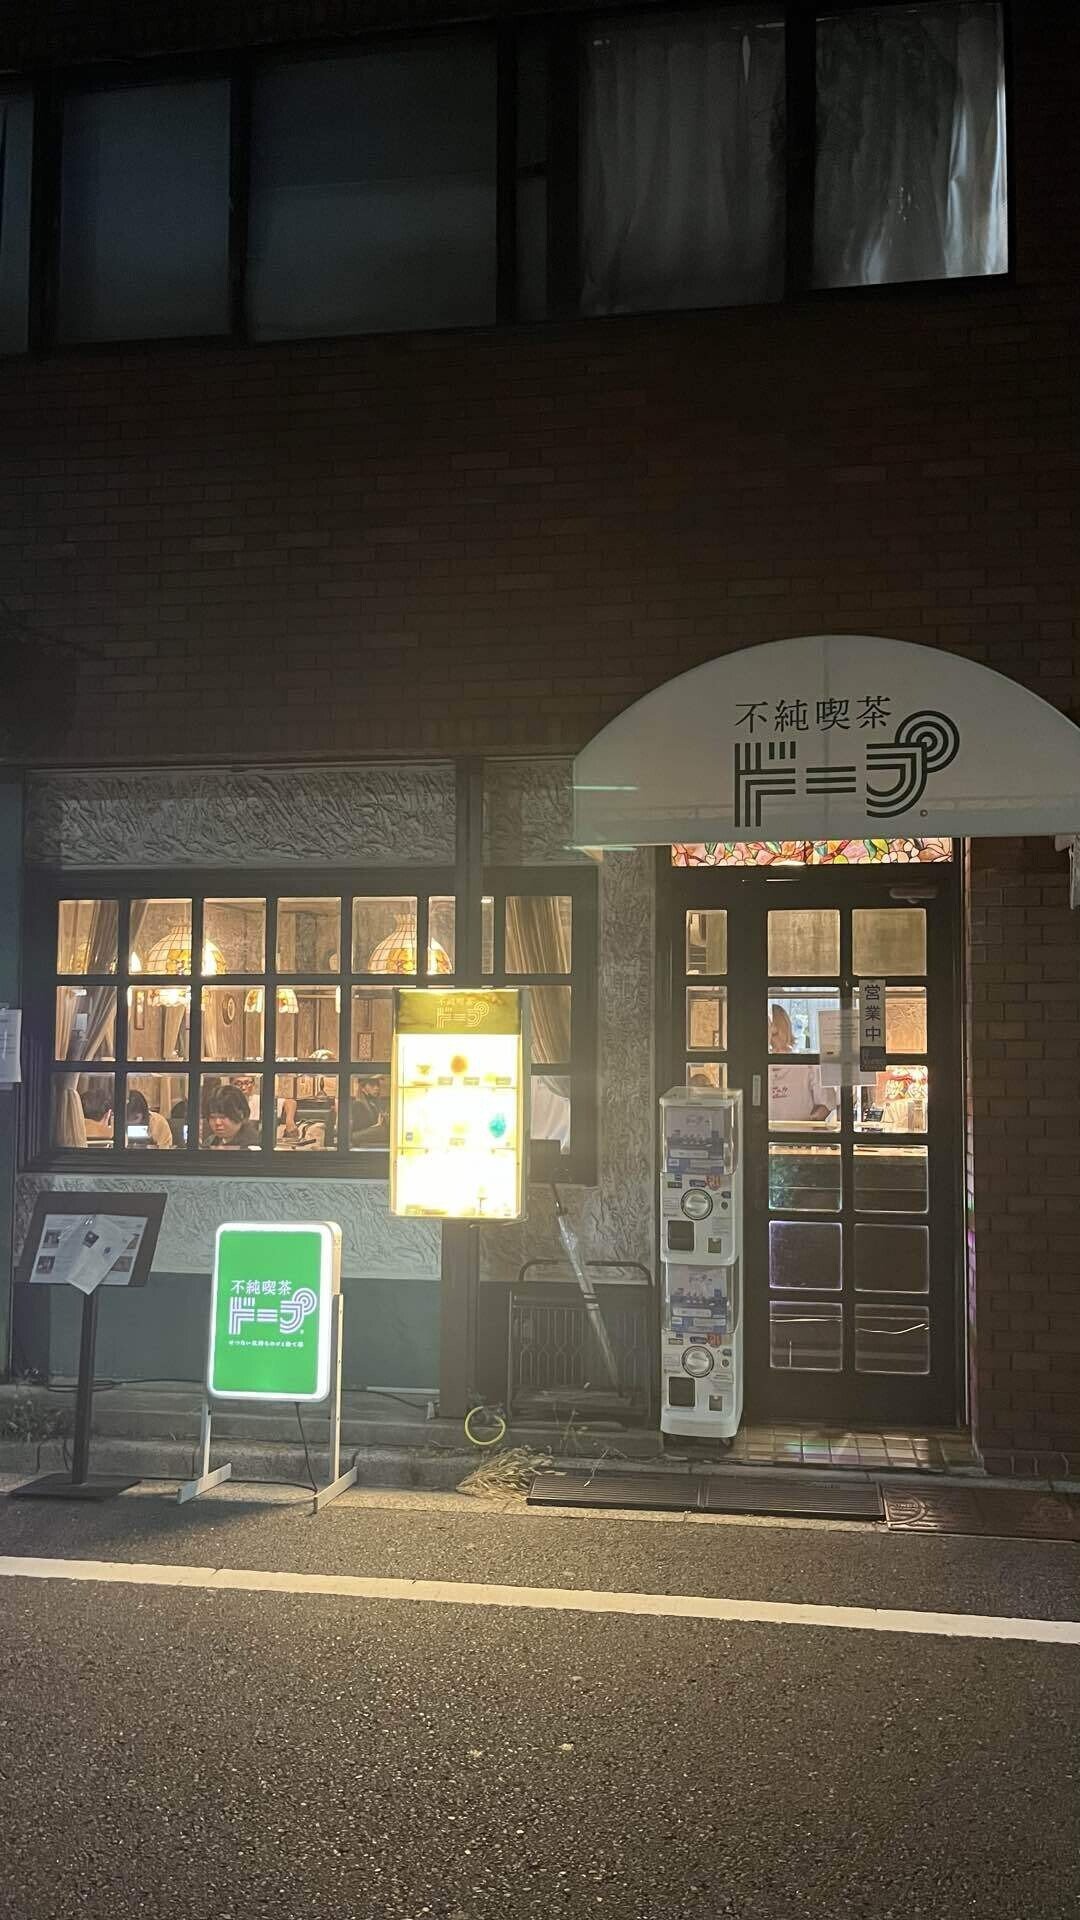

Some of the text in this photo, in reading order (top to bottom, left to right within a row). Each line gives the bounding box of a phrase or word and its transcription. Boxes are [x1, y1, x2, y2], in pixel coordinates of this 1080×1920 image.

[735, 696, 892, 733] 不純喫茶
[734, 710, 960, 827] ドープ
[864, 984, 882, 1042] 営業中
[228, 1287, 317, 1335] ドープ
[231, 1280, 292, 1296] 不純喫茶
